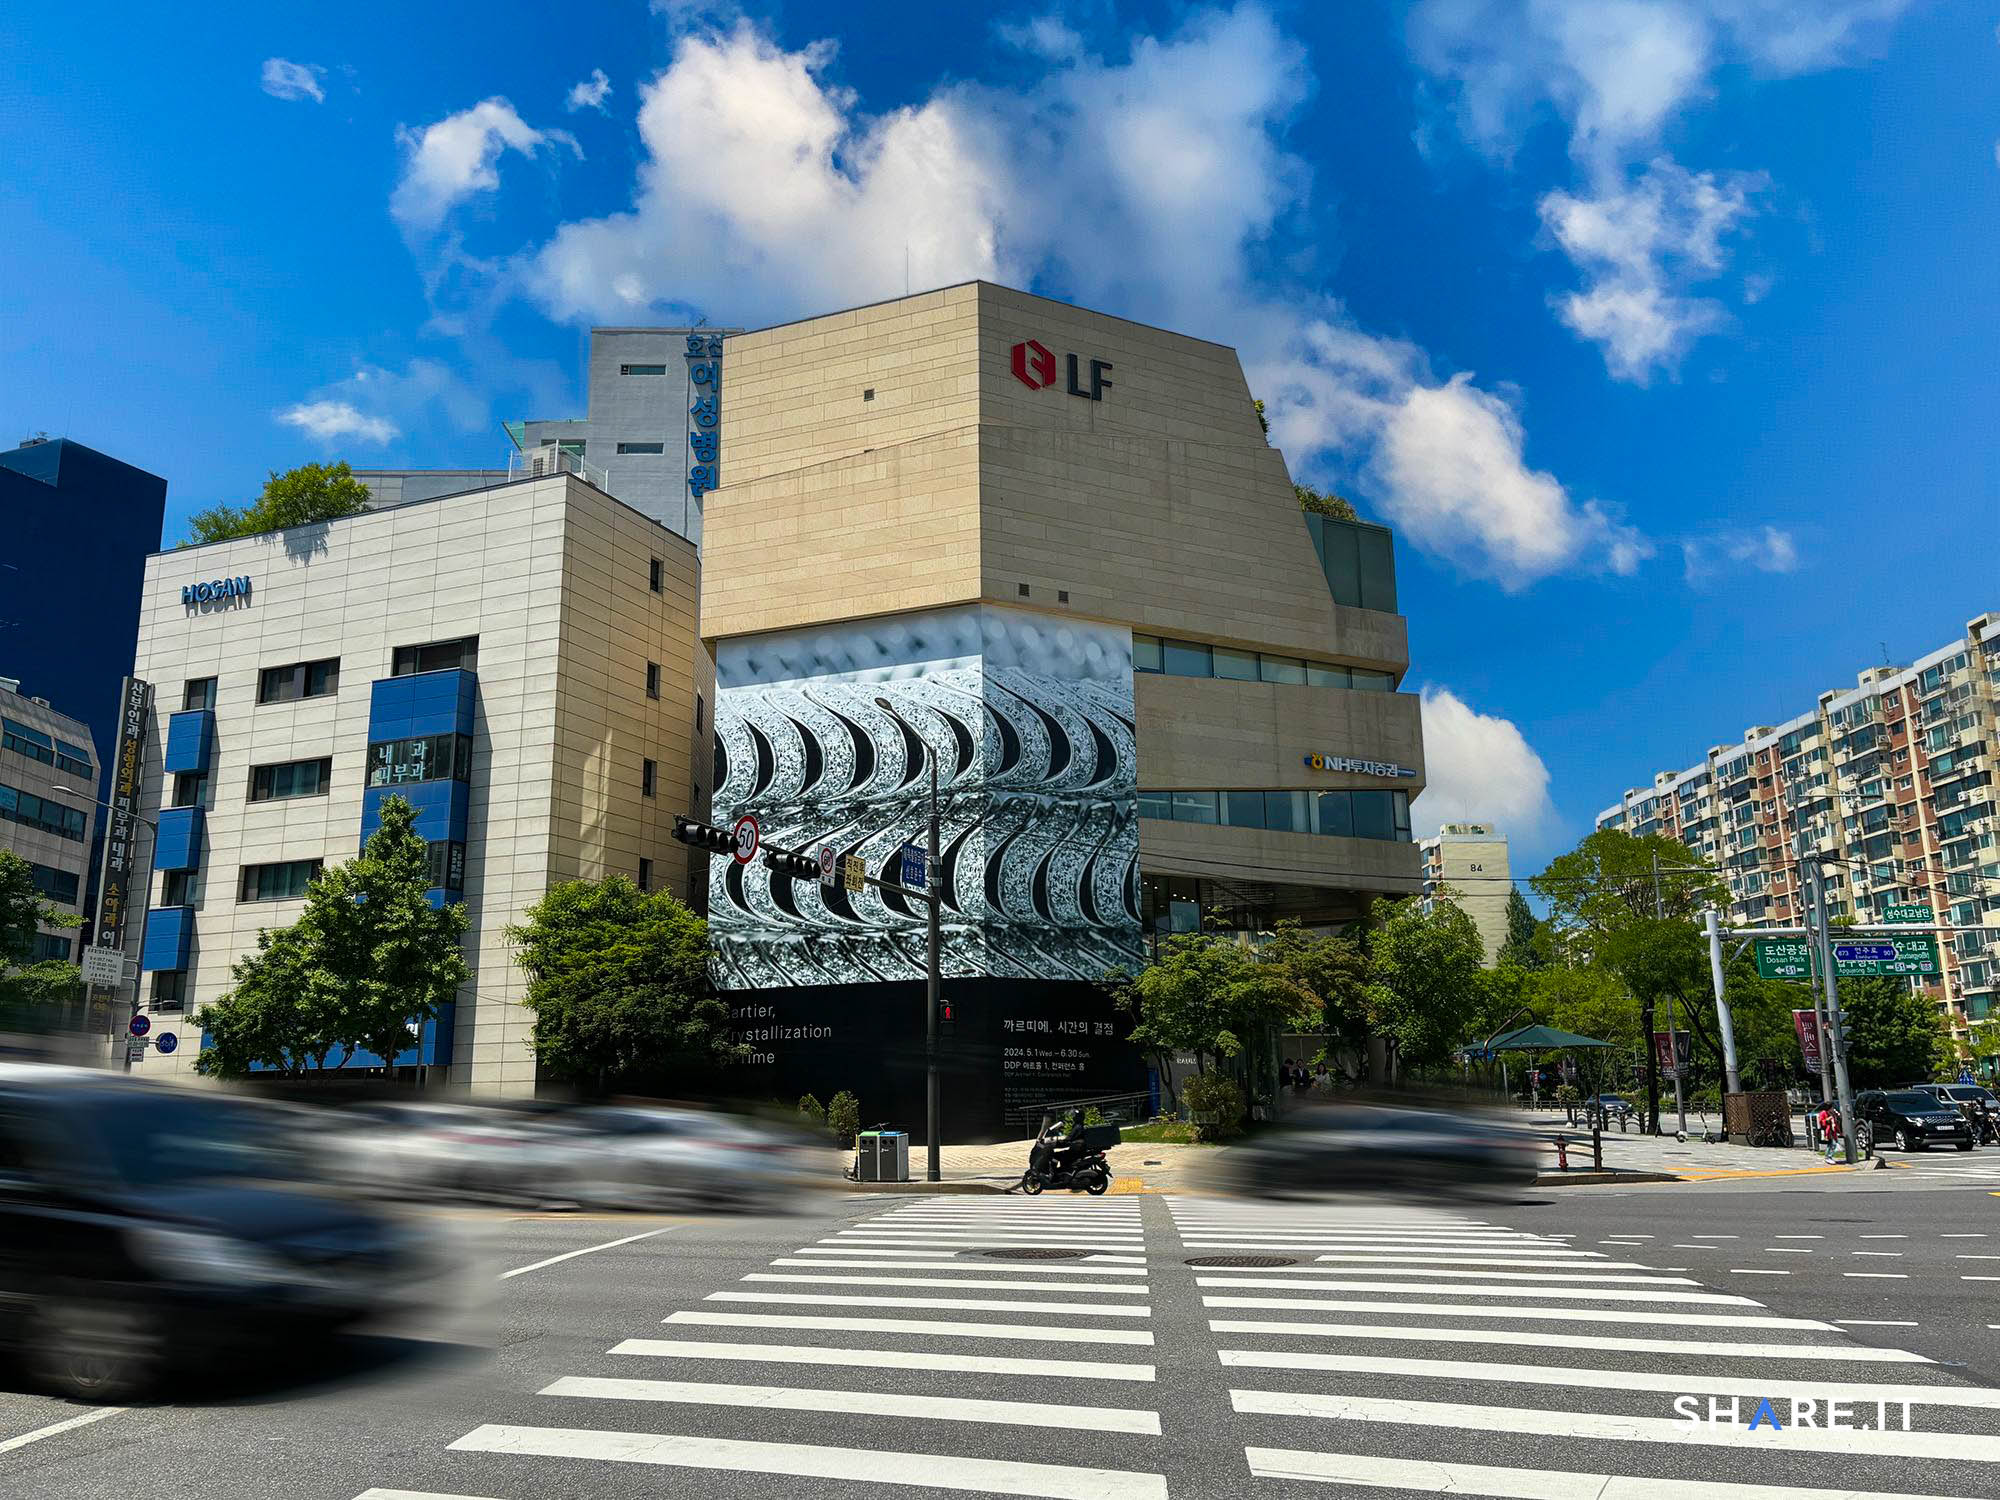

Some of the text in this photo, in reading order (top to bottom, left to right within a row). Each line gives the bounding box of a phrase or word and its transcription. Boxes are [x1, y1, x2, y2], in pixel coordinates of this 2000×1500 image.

[1067, 353, 1113, 401] LF
[689, 362, 718, 497] 여성병원
[181, 576, 250, 604] HOSAN
[126, 682, 145, 739] 산부인과
[376, 761, 426, 784] 피부과
[739, 827, 754, 850] 50
[110, 842, 125, 872] 내과
[1470, 863, 1482, 871] 84
[103, 883, 120, 928] 소아과
[1765, 945, 1808, 956] 도산공원
[1895, 941, 1929, 952] 수대교
[1896, 963, 1905, 971] 51
[731, 1003, 776, 1019] artier,
[730, 1023, 832, 1042] rystallization
[1058, 1020, 1088, 1034] 시간의
[1093, 1022, 1114, 1036] 결정
[1004, 1061, 1020, 1070] DDP
